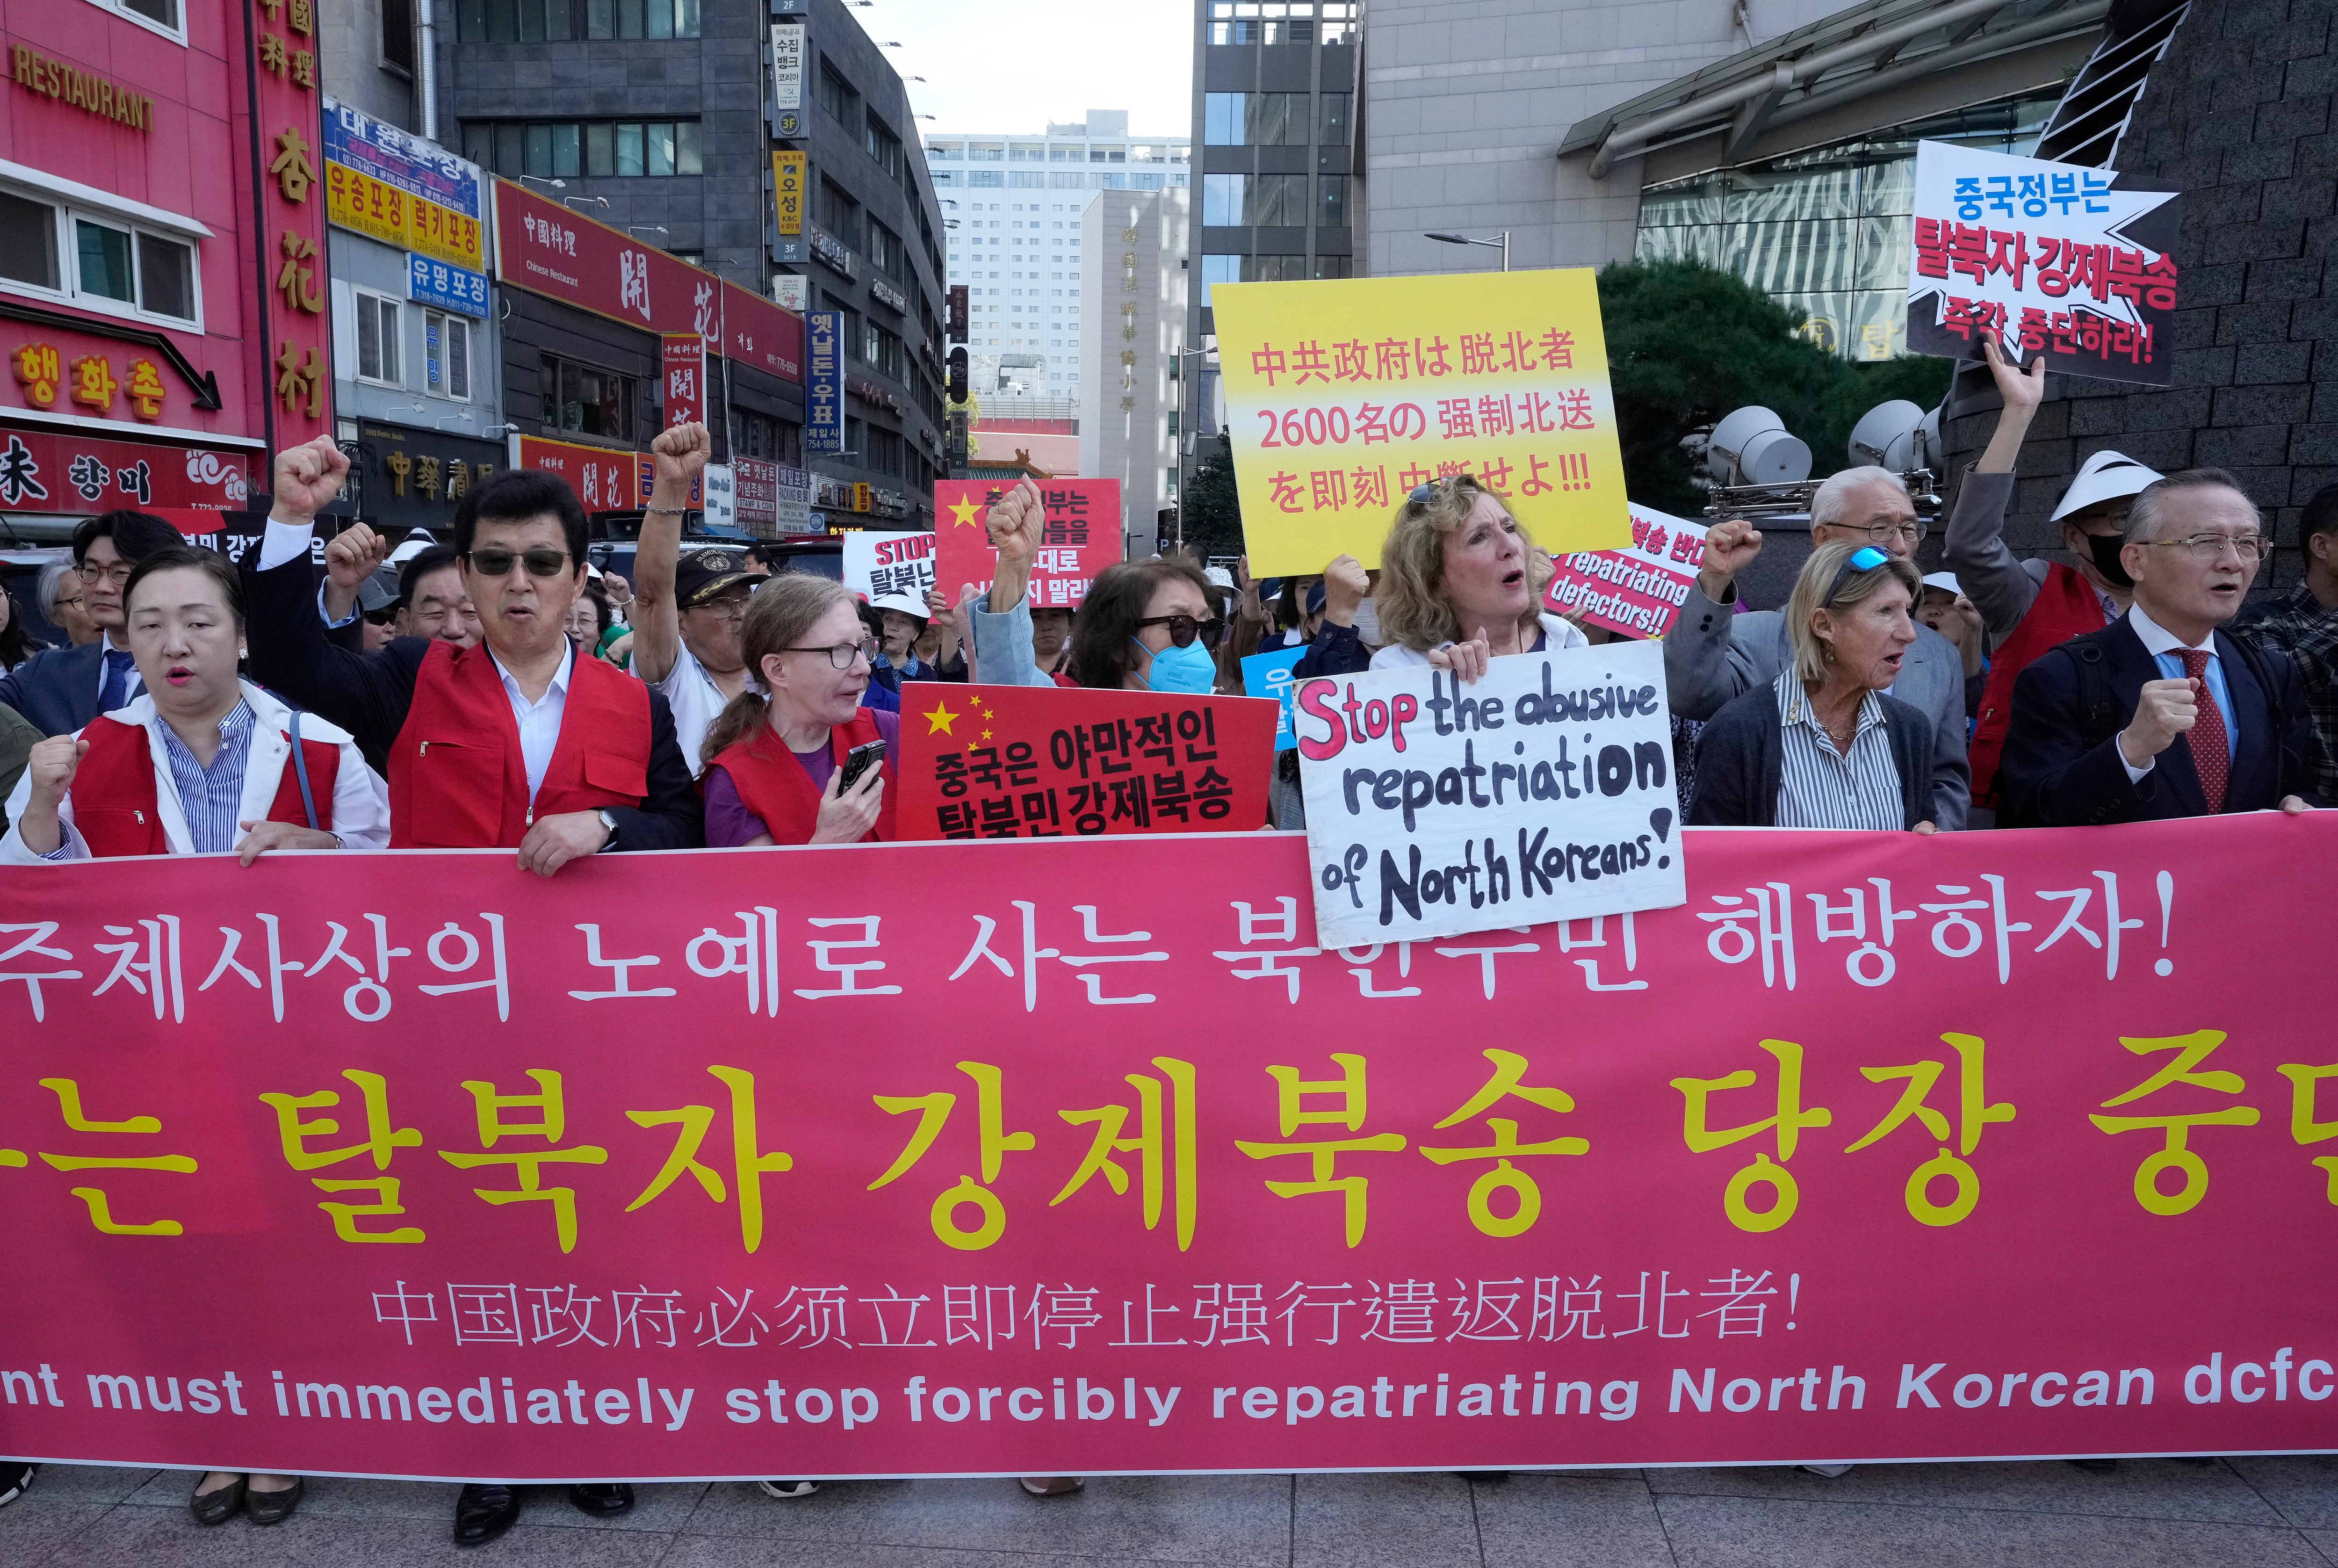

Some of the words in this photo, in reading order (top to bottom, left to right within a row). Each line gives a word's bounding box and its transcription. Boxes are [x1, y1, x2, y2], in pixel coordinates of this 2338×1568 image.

[777, 39, 798, 52] 수집
[778, 56, 799, 69] 뱅크
[14, 44, 155, 133] RESTAURANT
[779, 73, 799, 82] 코리아
[783, 118, 794, 129] 3F
[332, 166, 402, 227] 우송포장
[781, 178, 798, 212] 오성
[1954, 172, 2110, 220] 중국정부는
[416, 199, 476, 254] 럭키포장
[524, 212, 576, 257] 中國料理
[785, 245, 795, 253] 3F
[271, 127, 324, 418] 杏花村
[414, 260, 484, 302] 유명포장
[527, 260, 548, 276] Chinese
[550, 268, 579, 287] Restaurant
[1914, 216, 2029, 292] 탈북자
[2034, 236, 2177, 311] 강제북송
[620, 250, 719, 342] 開花
[738, 332, 753, 354] 개화
[1943, 296, 2007, 344] 즉각
[2018, 307, 2153, 364] 중단하라!
[18, 343, 166, 419] 행화촌
[808, 428, 839, 438] 제일사
[808, 440, 839, 448] 754-1885
[69, 455, 151, 505] 향미
[583, 462, 622, 508] 開花
[754, 464, 774, 482] 옛날돈
[779, 487, 795, 501] PACKING
[780, 469, 808, 487] 제일포장
[739, 499, 755, 507] STAMP
[696, 549, 727, 562] PANMUNJOM
[875, 534, 935, 566] STOP
[1161, 539, 1169, 551] P
[1565, 551, 1690, 607] repatriating
[1551, 576, 1669, 636] defectors!!
[1298, 679, 1418, 761] Stop
[1425, 669, 1504, 736] the
[1515, 661, 1659, 725] abusive
[935, 742, 1038, 797] 중국은
[1050, 707, 1217, 778] 야만적인
[1068, 766, 1233, 836] 강제북송
[1342, 733, 1667, 832] repatriation
[1321, 843, 1368, 908] of
[1379, 838, 1510, 926] North
[1519, 808, 1673, 898] Koreans!
[0, 912, 510, 1024] 주체사상의
[568, 906, 902, 1018] 노예로
[949, 900, 1170, 1012] 사는
[1696, 870, 2173, 991] 해방하자!
[259, 1065, 793, 1254] 탈북자
[866, 1048, 1590, 1252] 강제북송
[1670, 1032, 2016, 1233] 당장
[87, 1371, 247, 1416] must
[272, 1370, 695, 1431] immediately
[726, 1380, 879, 1430] stop
[904, 1375, 1182, 1427] forcibly
[1213, 1371, 1639, 1425] repatriating
[1668, 1365, 1866, 1413] North
